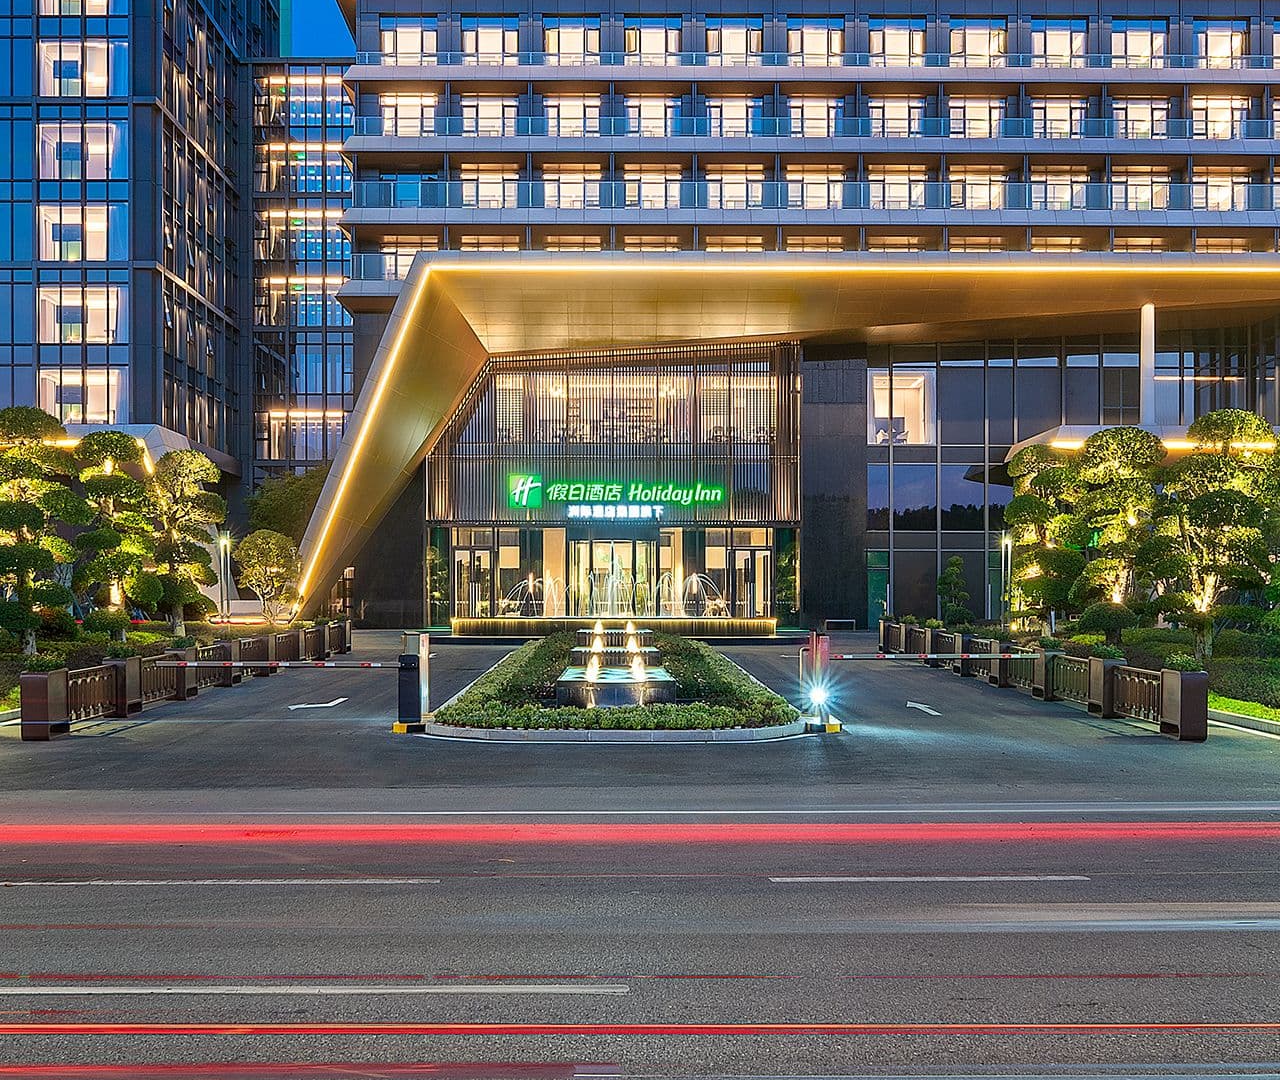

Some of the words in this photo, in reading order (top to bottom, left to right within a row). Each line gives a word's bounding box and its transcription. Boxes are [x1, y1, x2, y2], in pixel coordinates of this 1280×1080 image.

[546, 483, 624, 501] 假日酒店
[628, 483, 696, 505] Holiday
[695, 483, 721, 501] Inn
